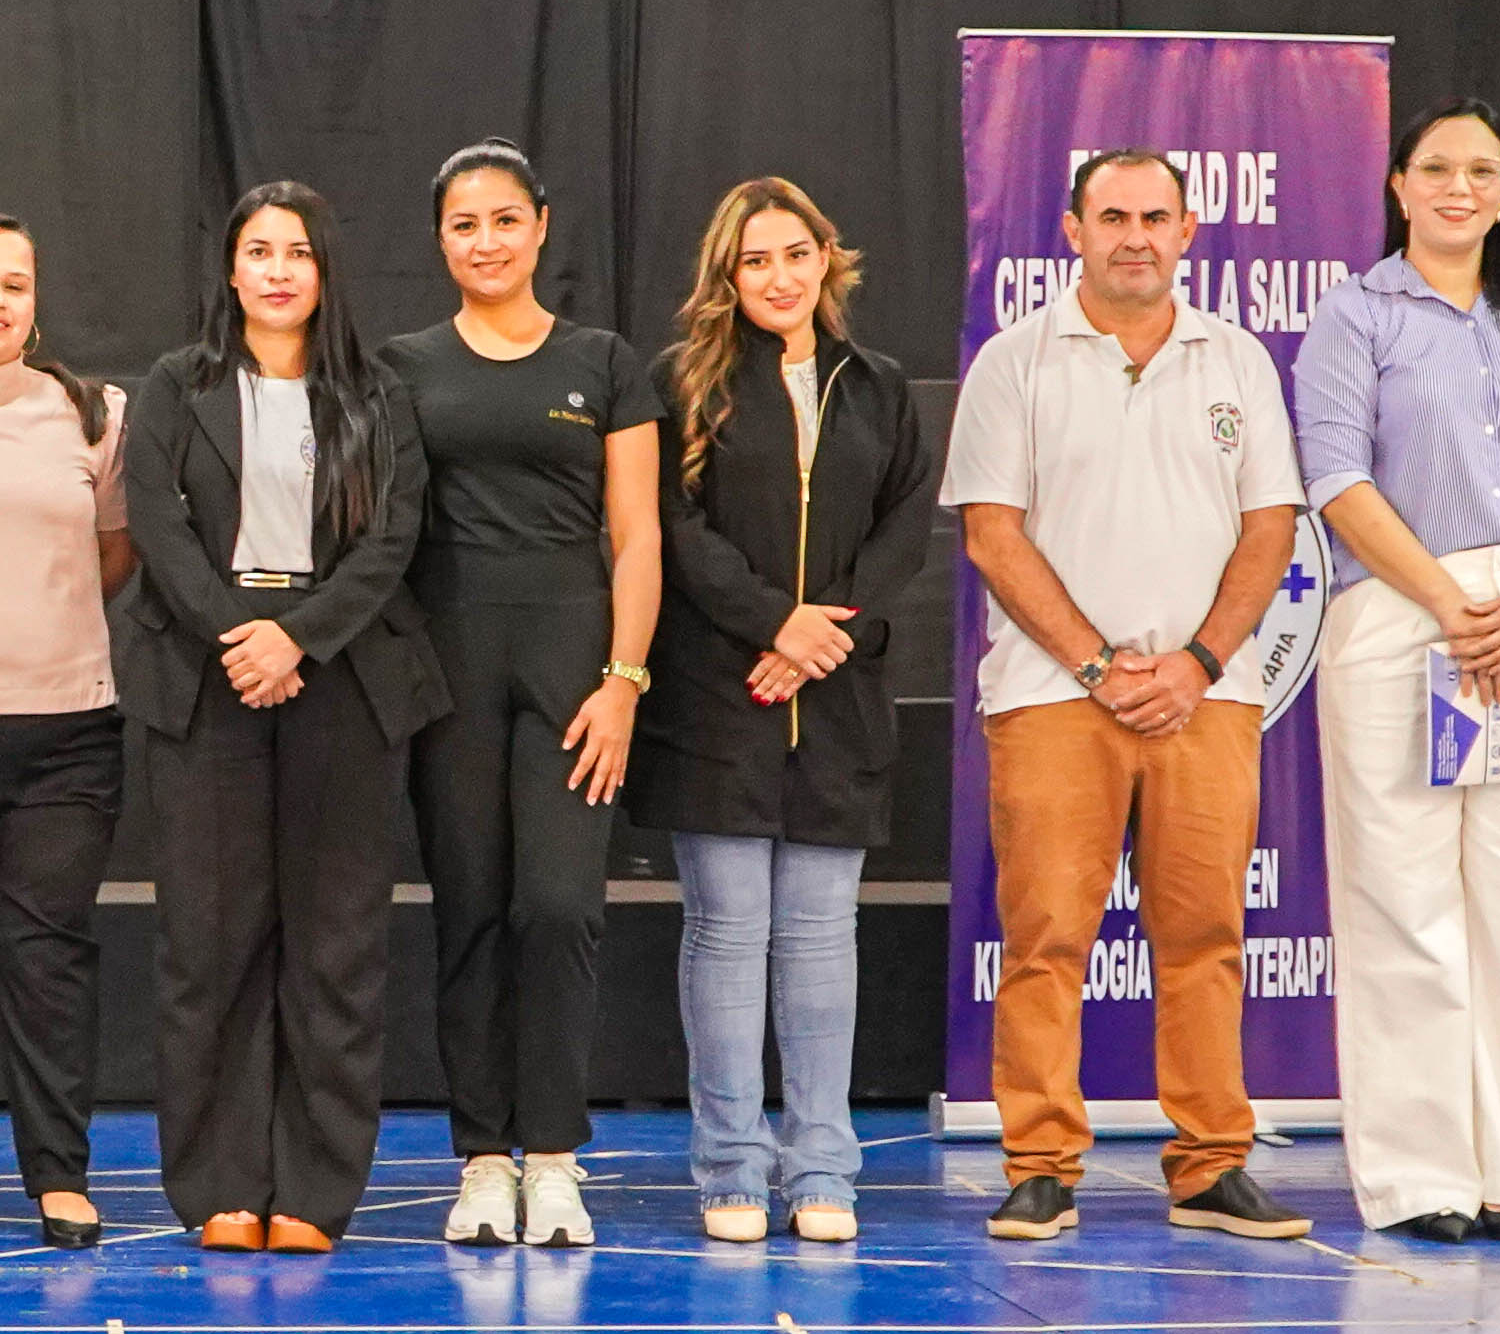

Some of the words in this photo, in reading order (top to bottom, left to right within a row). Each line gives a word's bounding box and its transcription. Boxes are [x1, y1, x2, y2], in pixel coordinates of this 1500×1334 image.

[1237, 151, 1277, 225] DE
[1199, 259, 1241, 328] LA
[1246, 848, 1279, 909] EN
